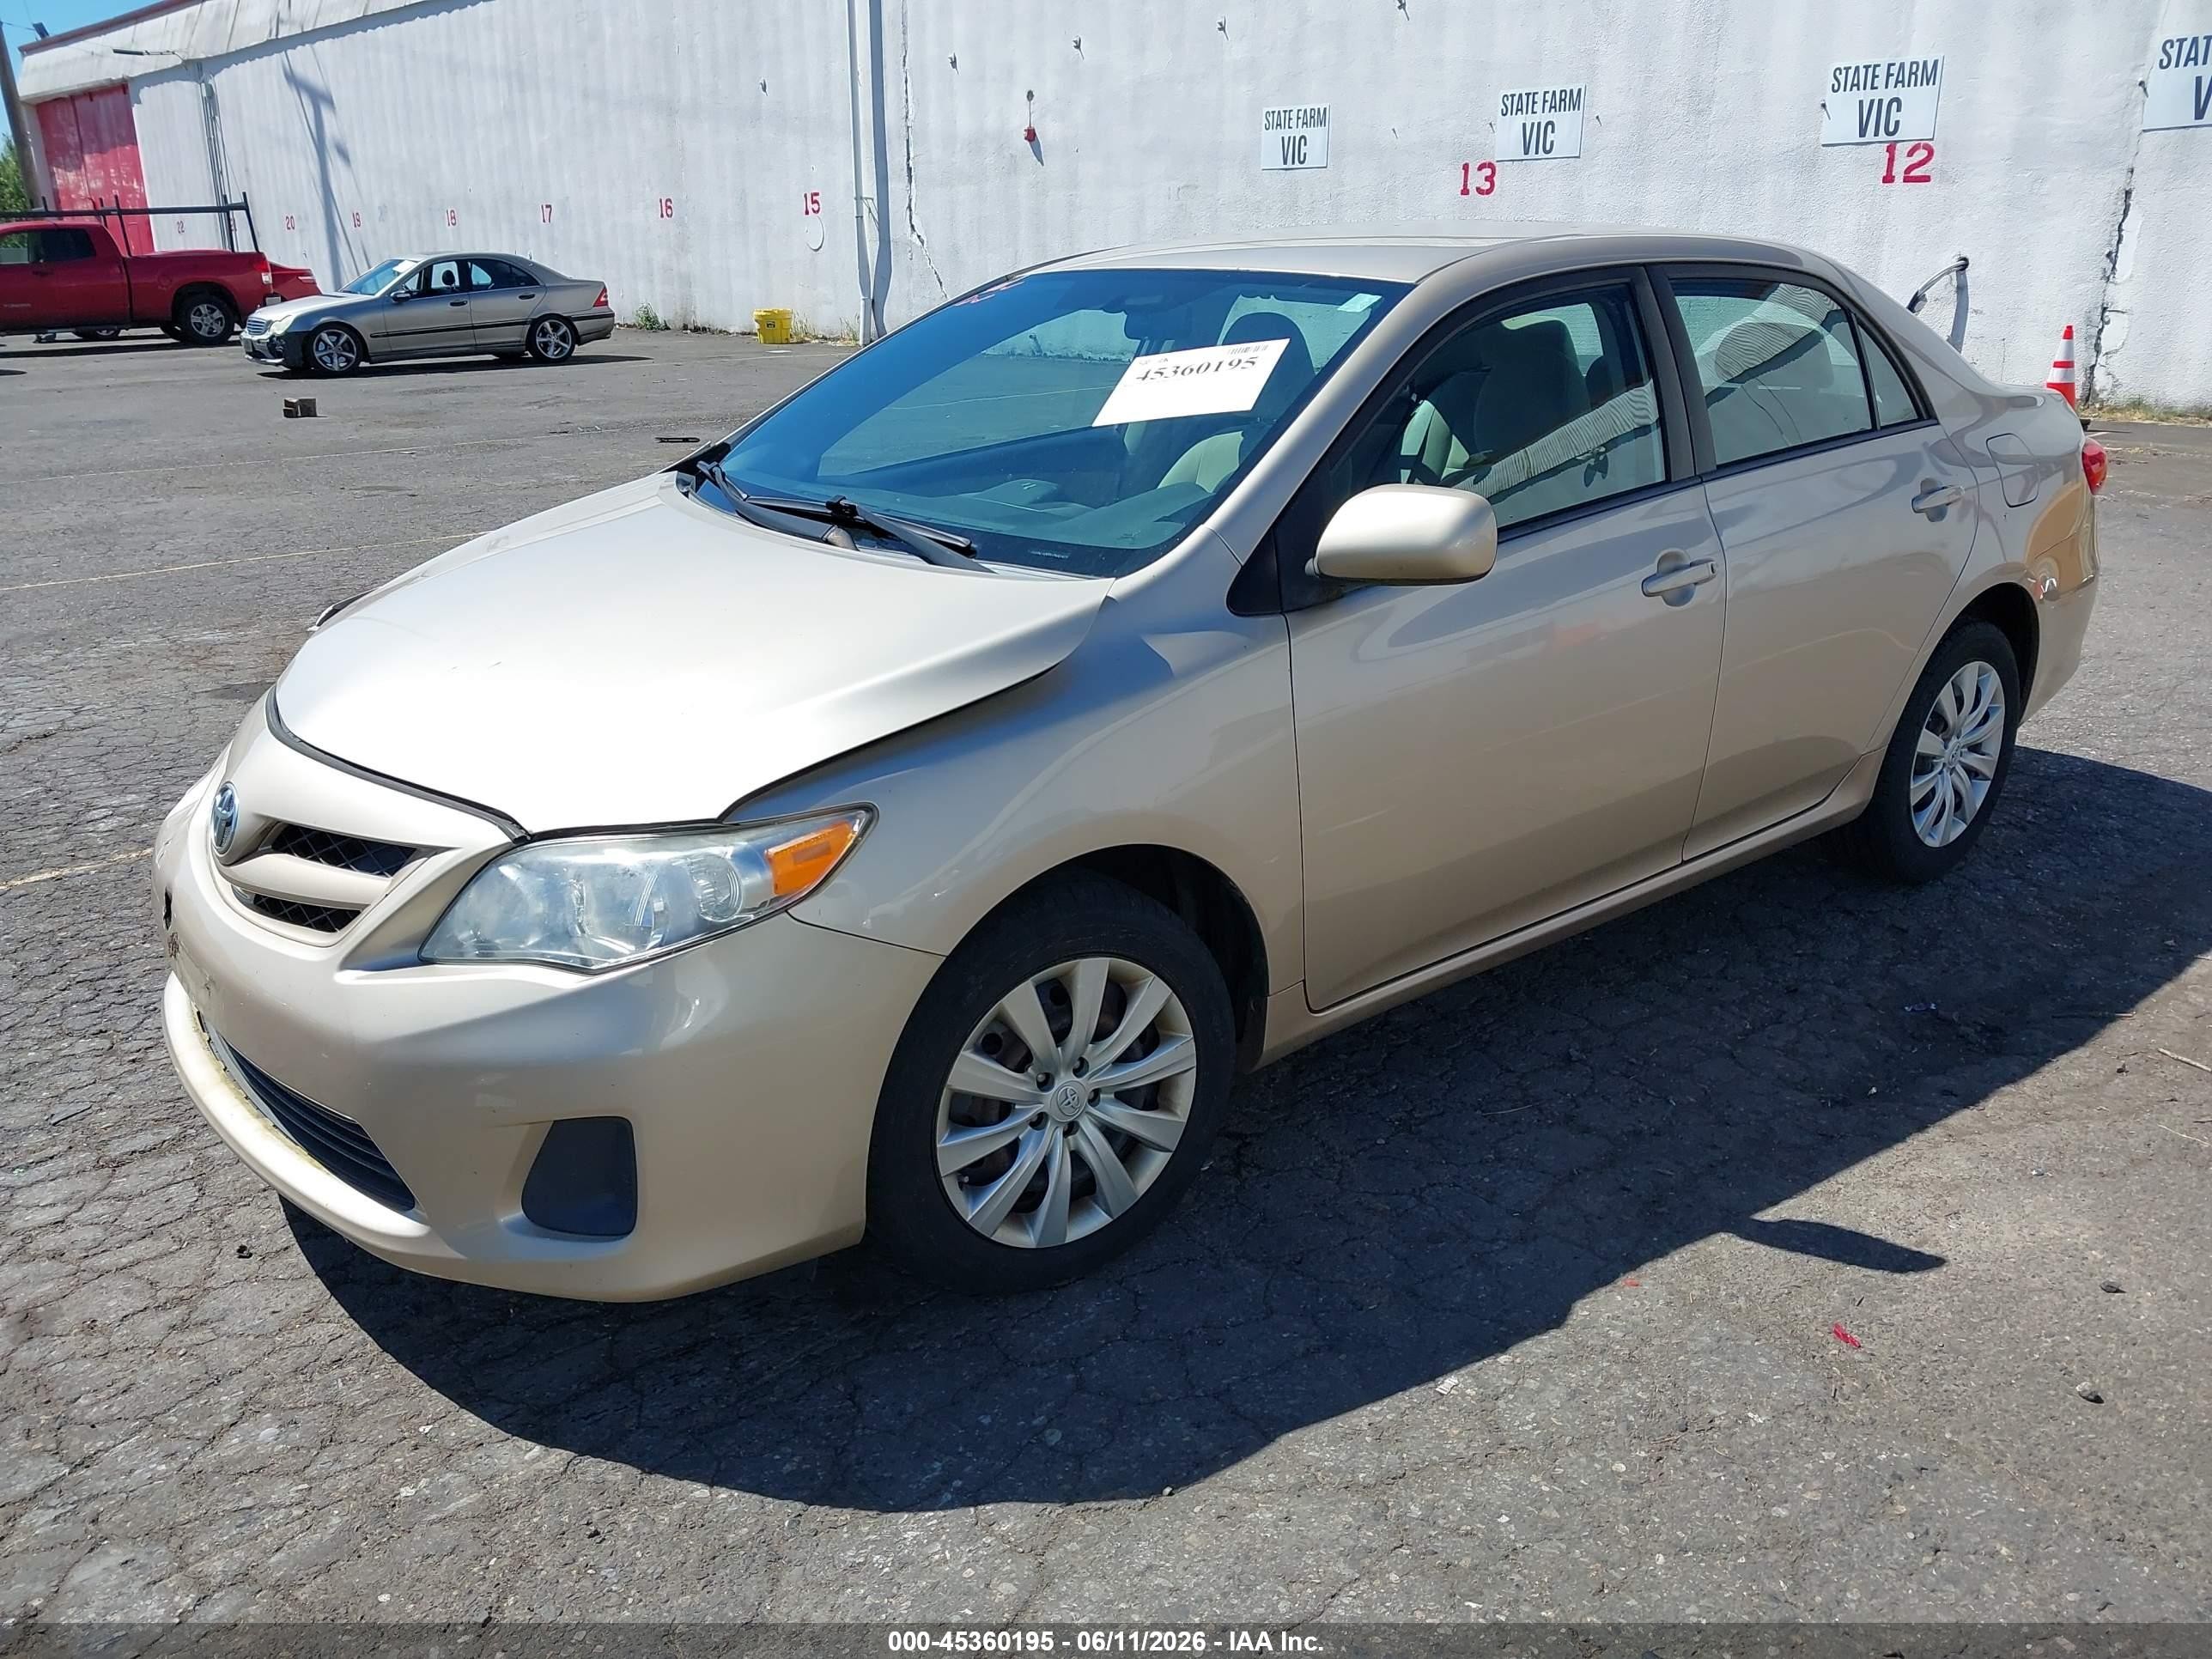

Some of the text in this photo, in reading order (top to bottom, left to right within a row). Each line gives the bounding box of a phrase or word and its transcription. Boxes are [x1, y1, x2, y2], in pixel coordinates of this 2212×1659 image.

[1832, 59, 1939, 94] STATE FARM
[1501, 88, 1582, 117] STATE FARM
[1265, 107, 1327, 131] STATE FARM
[1858, 97, 1902, 137] VIC
[1281, 135, 1307, 166] VIC
[1522, 120, 1555, 155] VIC
[1881, 142, 1935, 184] 12
[1460, 161, 1497, 196] 13
[541, 204, 552, 223] 17
[659, 198, 673, 218] 16
[804, 192, 821, 216] 15
[285, 216, 295, 230] 20
[447, 210, 456, 227] 18
[1136, 356, 1258, 381] 45360195
